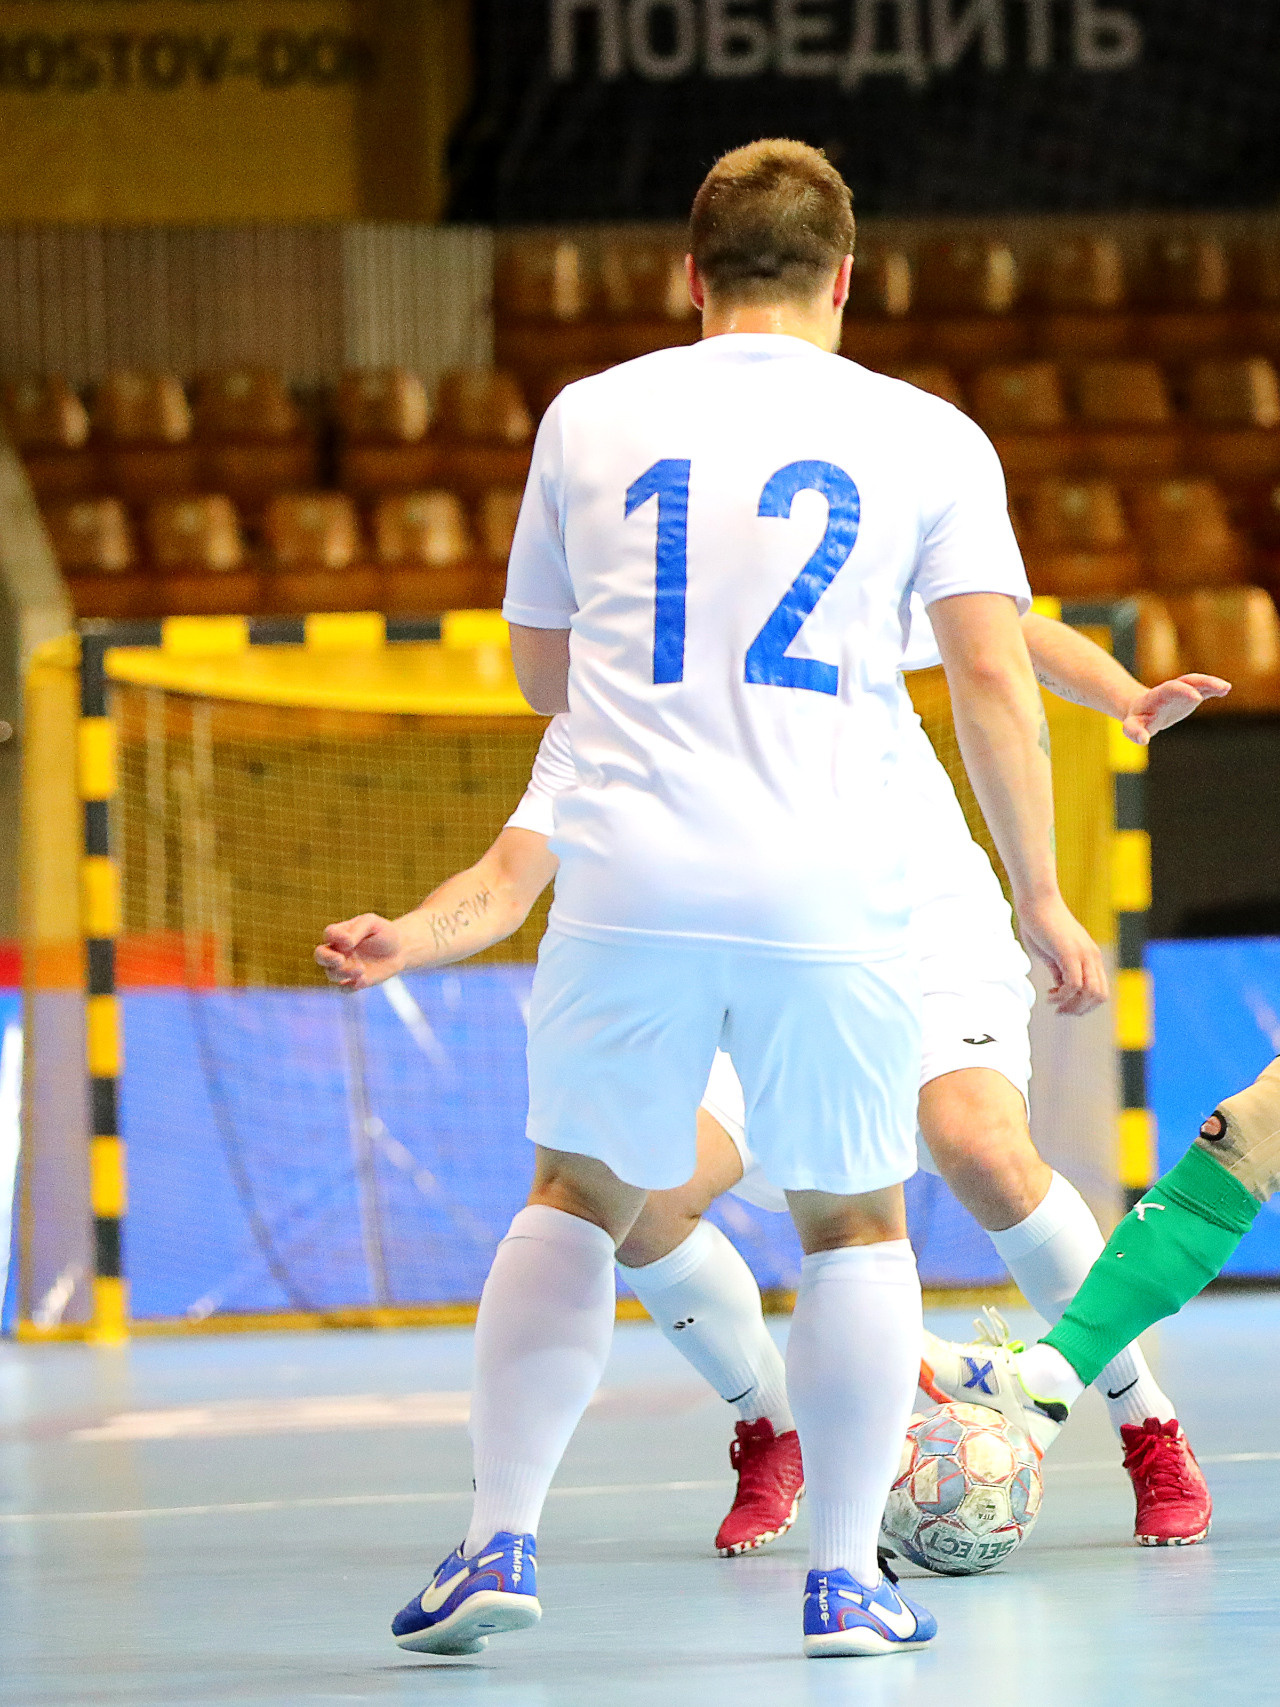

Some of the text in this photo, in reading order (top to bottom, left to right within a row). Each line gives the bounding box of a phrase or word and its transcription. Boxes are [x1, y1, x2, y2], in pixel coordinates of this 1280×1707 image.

[547, 0, 1143, 90] ПОБЕДИТЬ
[623, 458, 861, 697] 12
[924, 1531, 1016, 1560] SELECT
